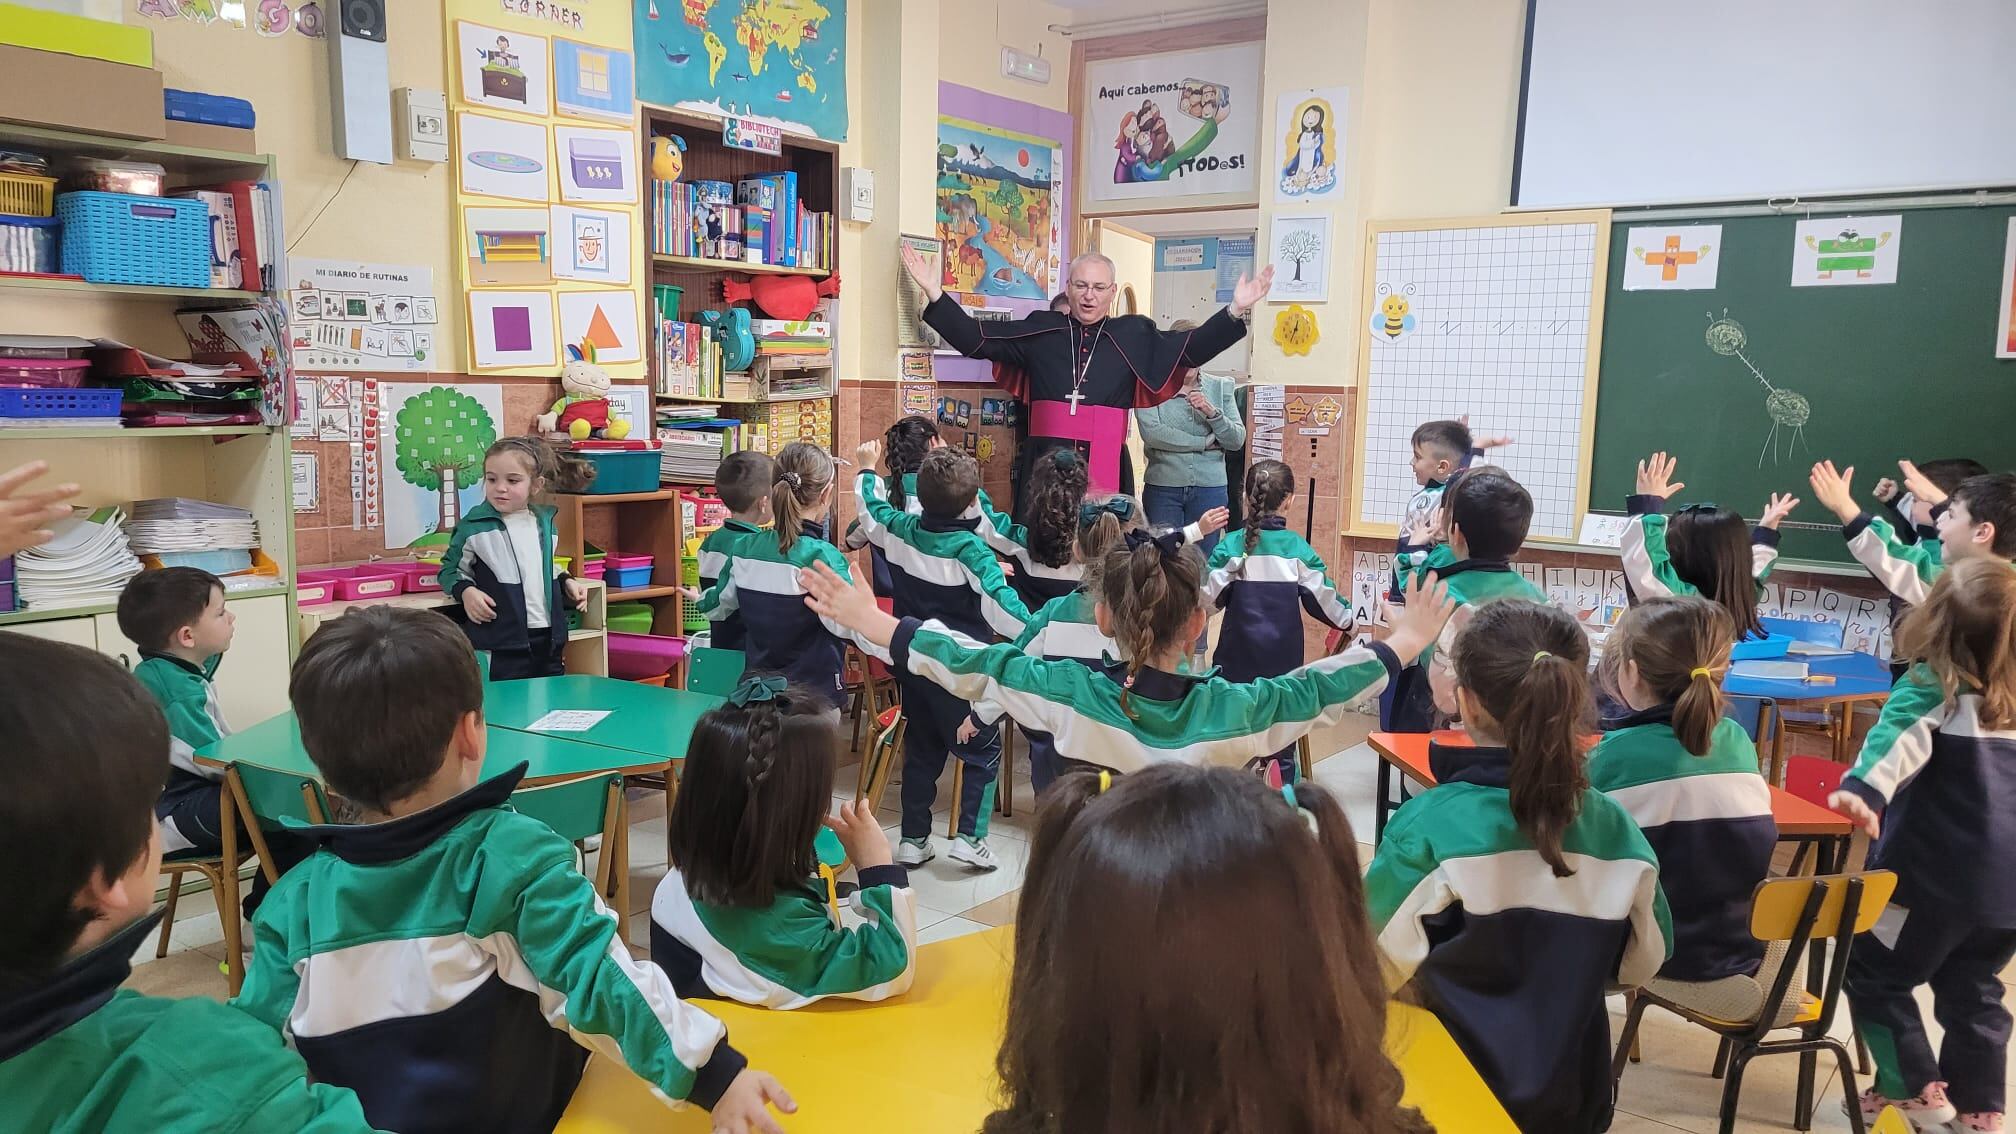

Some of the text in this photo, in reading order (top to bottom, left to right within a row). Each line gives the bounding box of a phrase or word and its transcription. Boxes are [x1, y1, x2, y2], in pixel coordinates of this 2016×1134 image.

[503, 0, 584, 30] CORNER
[1099, 85, 1125, 101] Aquí
[315, 268, 409, 282] MI DIARIO DE RUTINAS
[1358, 552, 1369, 569] A
[1378, 554, 1390, 571] B
[1581, 570, 1595, 587] J
[1609, 571, 1624, 591] K
[1789, 590, 1806, 609] P
[1822, 592, 1839, 612] Q
[1355, 606, 1368, 621] A
[1857, 599, 1876, 620] R
